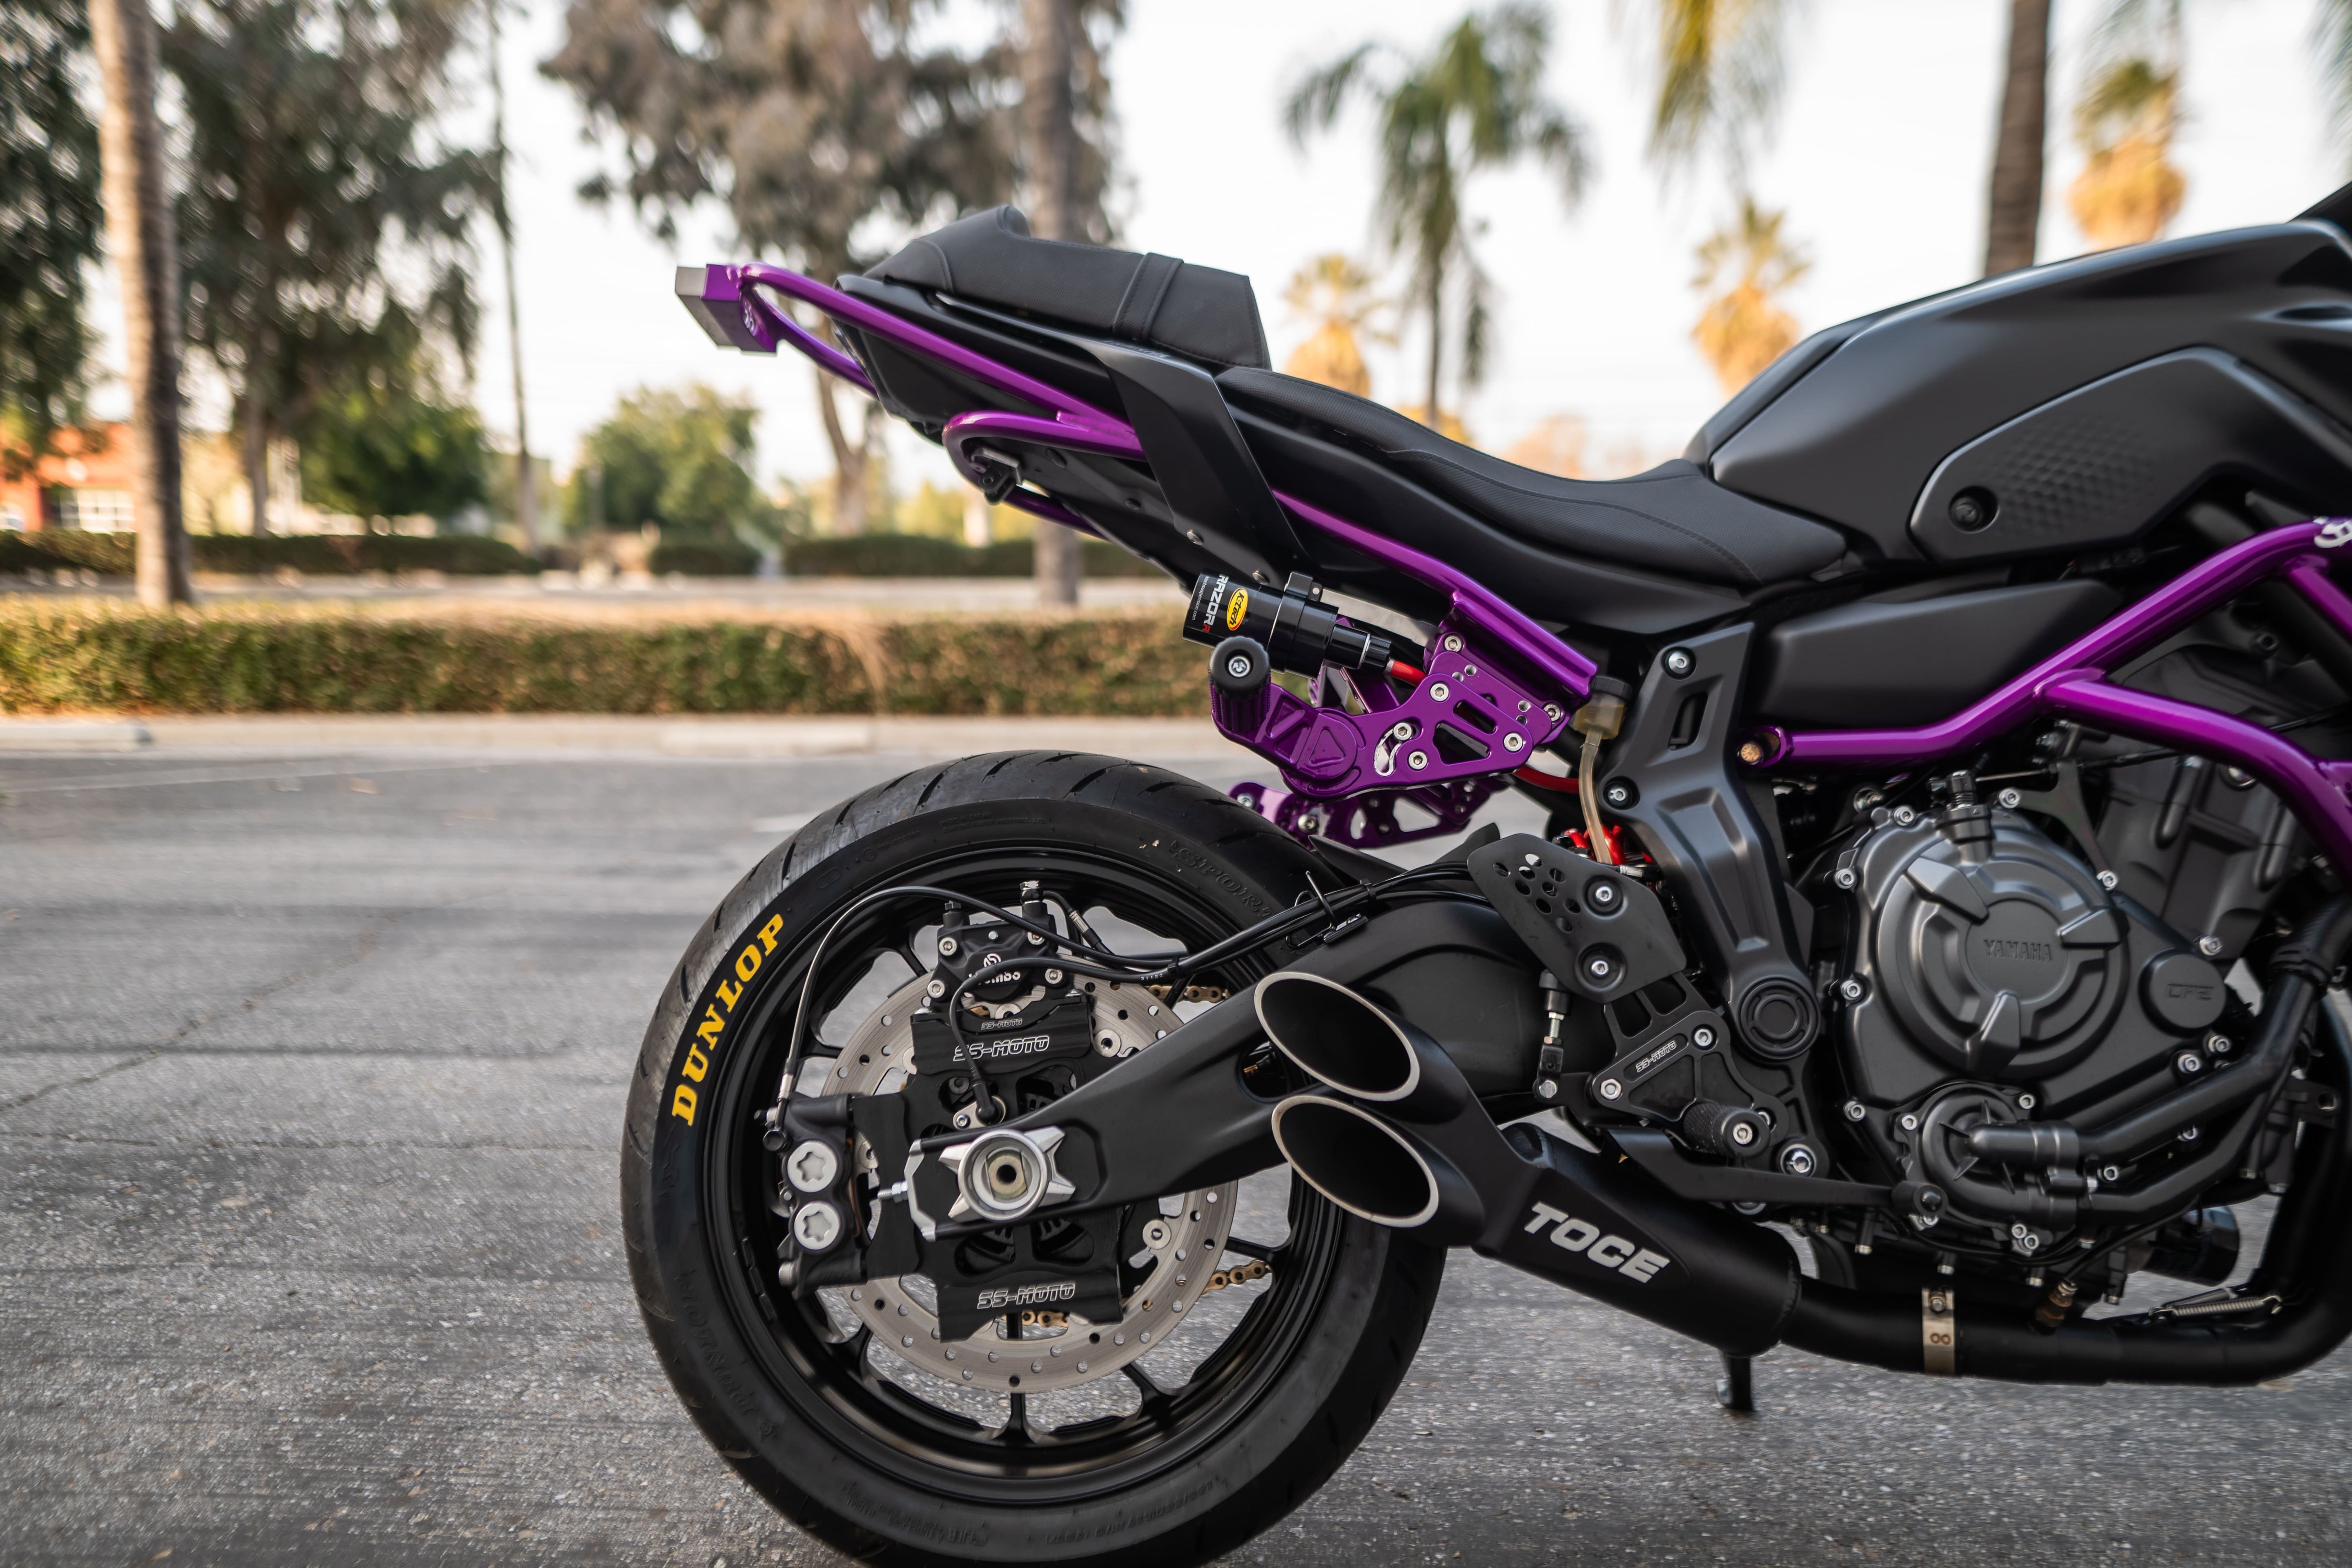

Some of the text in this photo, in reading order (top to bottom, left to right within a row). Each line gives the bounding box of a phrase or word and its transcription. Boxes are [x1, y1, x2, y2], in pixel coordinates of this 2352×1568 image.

[1983, 939, 2053, 962] YAMAHA
[672, 914, 784, 1126] DUNLOP
[981, 1018, 1023, 1030] SS-MOTO
[953, 1035, 1050, 1062] SS-MOTO
[1635, 1040, 1676, 1073] SS-MOTO
[1524, 1201, 1670, 1283] TOCE
[977, 1281, 1076, 1309] SS-MOTO
